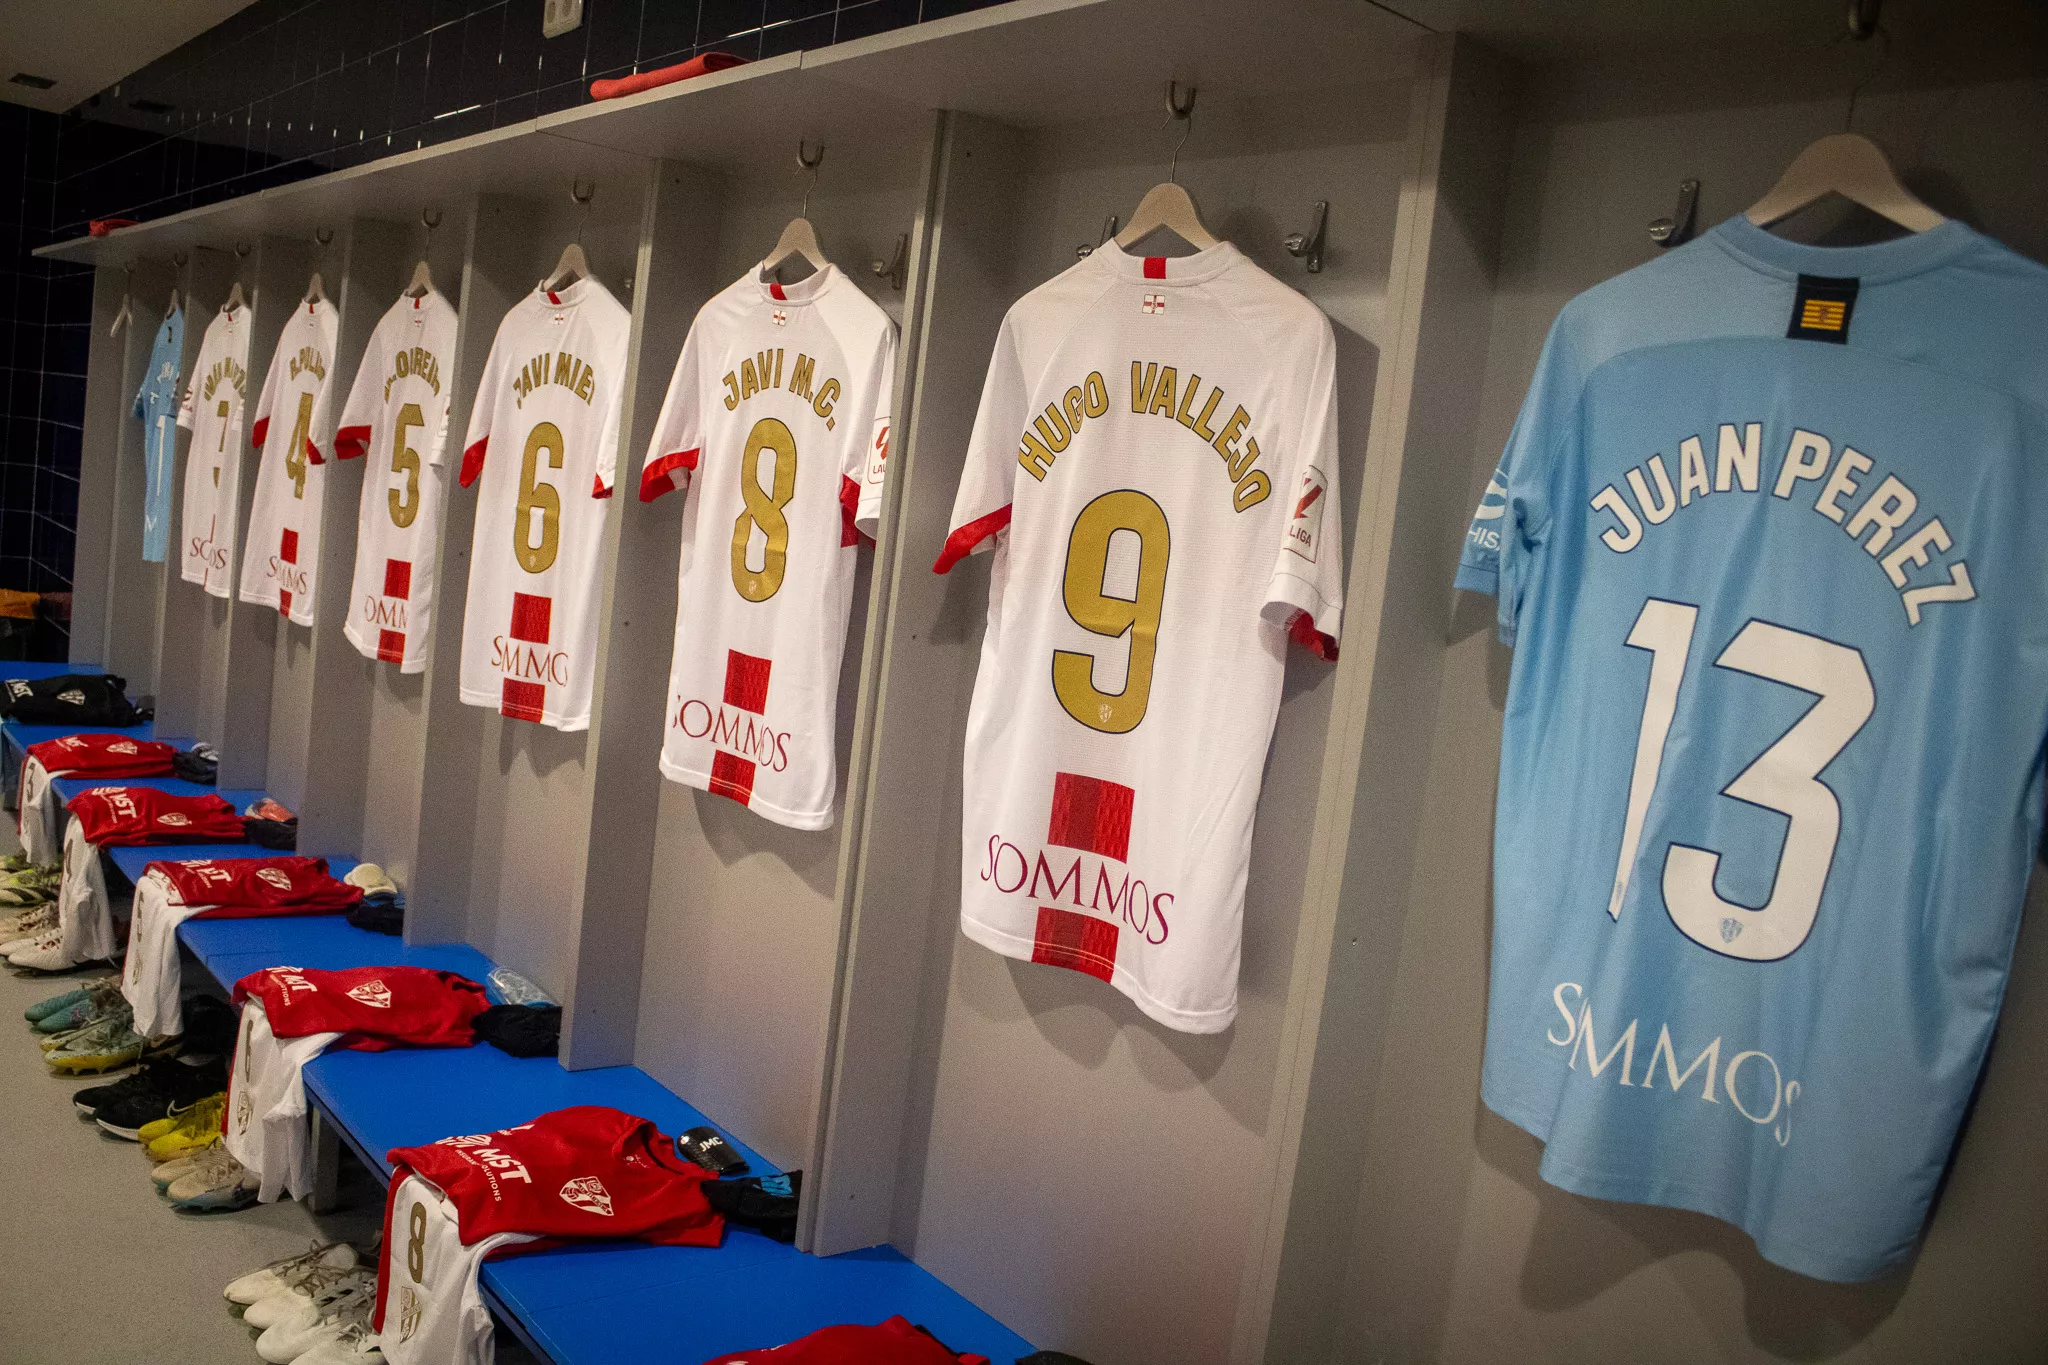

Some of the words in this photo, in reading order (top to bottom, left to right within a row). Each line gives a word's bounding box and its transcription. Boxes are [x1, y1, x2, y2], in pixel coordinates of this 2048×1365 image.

[554, 352, 595, 407] MIE
[722, 348, 784, 412] JAVI
[789, 353, 841, 431] M.C.
[1018, 371, 1109, 482] HUGO
[1131, 360, 1272, 513] VALLEJO
[286, 392, 313, 500] 4
[388, 403, 425, 528] 5
[513, 422, 565, 574] 6
[730, 417, 798, 603] 8
[1590, 421, 1763, 554] JUAN
[1772, 427, 1979, 628] PEREZ
[1051, 489, 1171, 735] 9
[1606, 596, 1877, 963] 13
[980, 834, 1175, 945] SOMMOS
[472, 1148, 532, 1184] MST
[699, 1135, 724, 1153] JMC
[408, 1201, 427, 1284] 8
